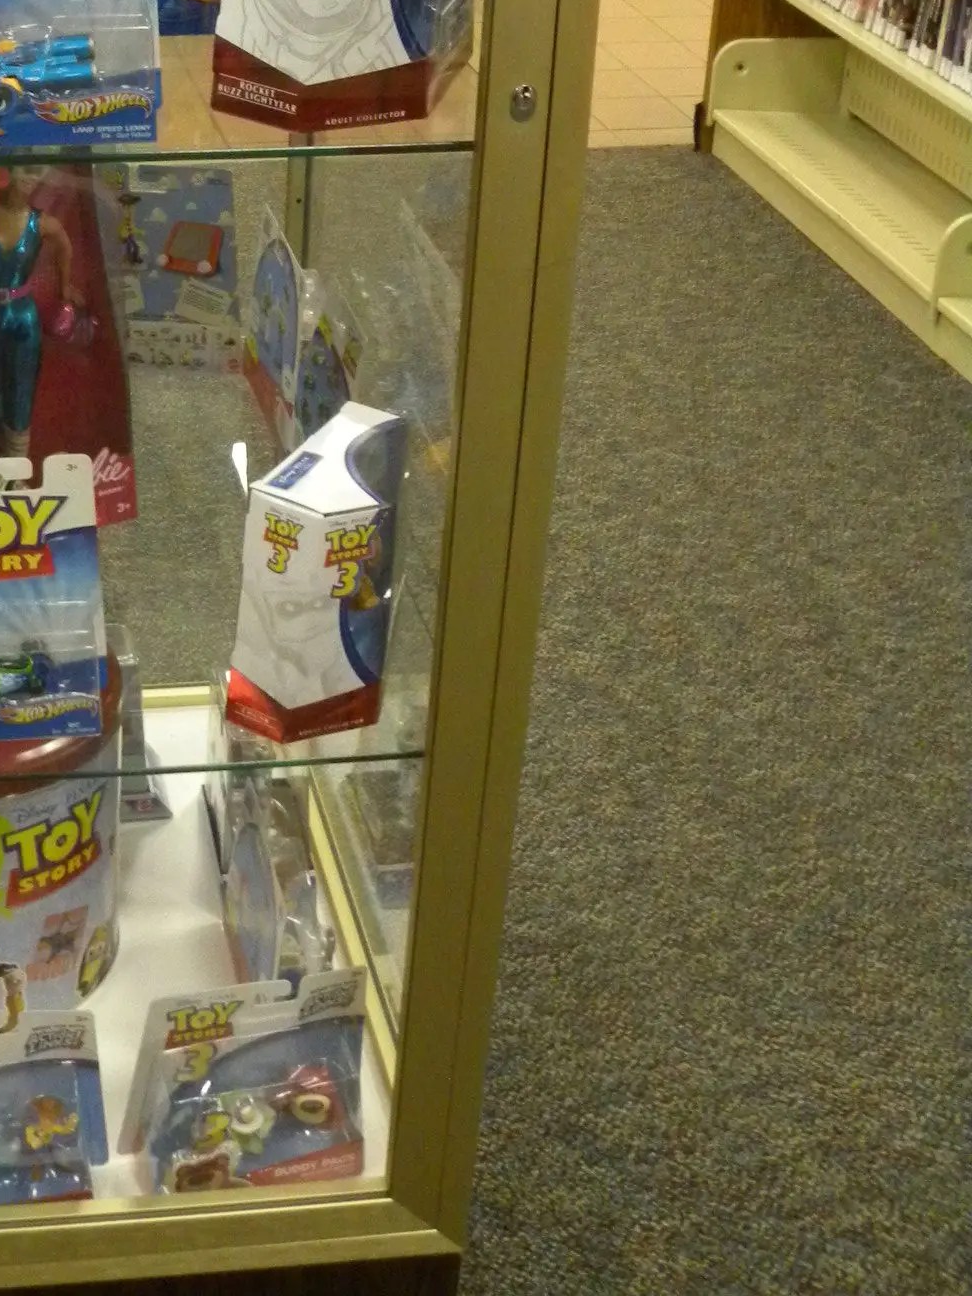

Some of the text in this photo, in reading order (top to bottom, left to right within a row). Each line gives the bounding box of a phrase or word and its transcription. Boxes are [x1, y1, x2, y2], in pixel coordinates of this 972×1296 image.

[217, 83, 298, 114] BUZZ LIGHTYEAR
[239, 80, 276, 98] ROCKET
[324, 110, 406, 126] ADULT COLLECTOR
[264, 511, 306, 539] TOY
[324, 524, 377, 551] TOY
[266, 542, 291, 574] 3
[330, 560, 360, 598] 3
[1, 782, 105, 875] TOY
[18, 841, 97, 895] STORY
[166, 999, 245, 1032] TOY
[174, 1041, 218, 1083] 3
